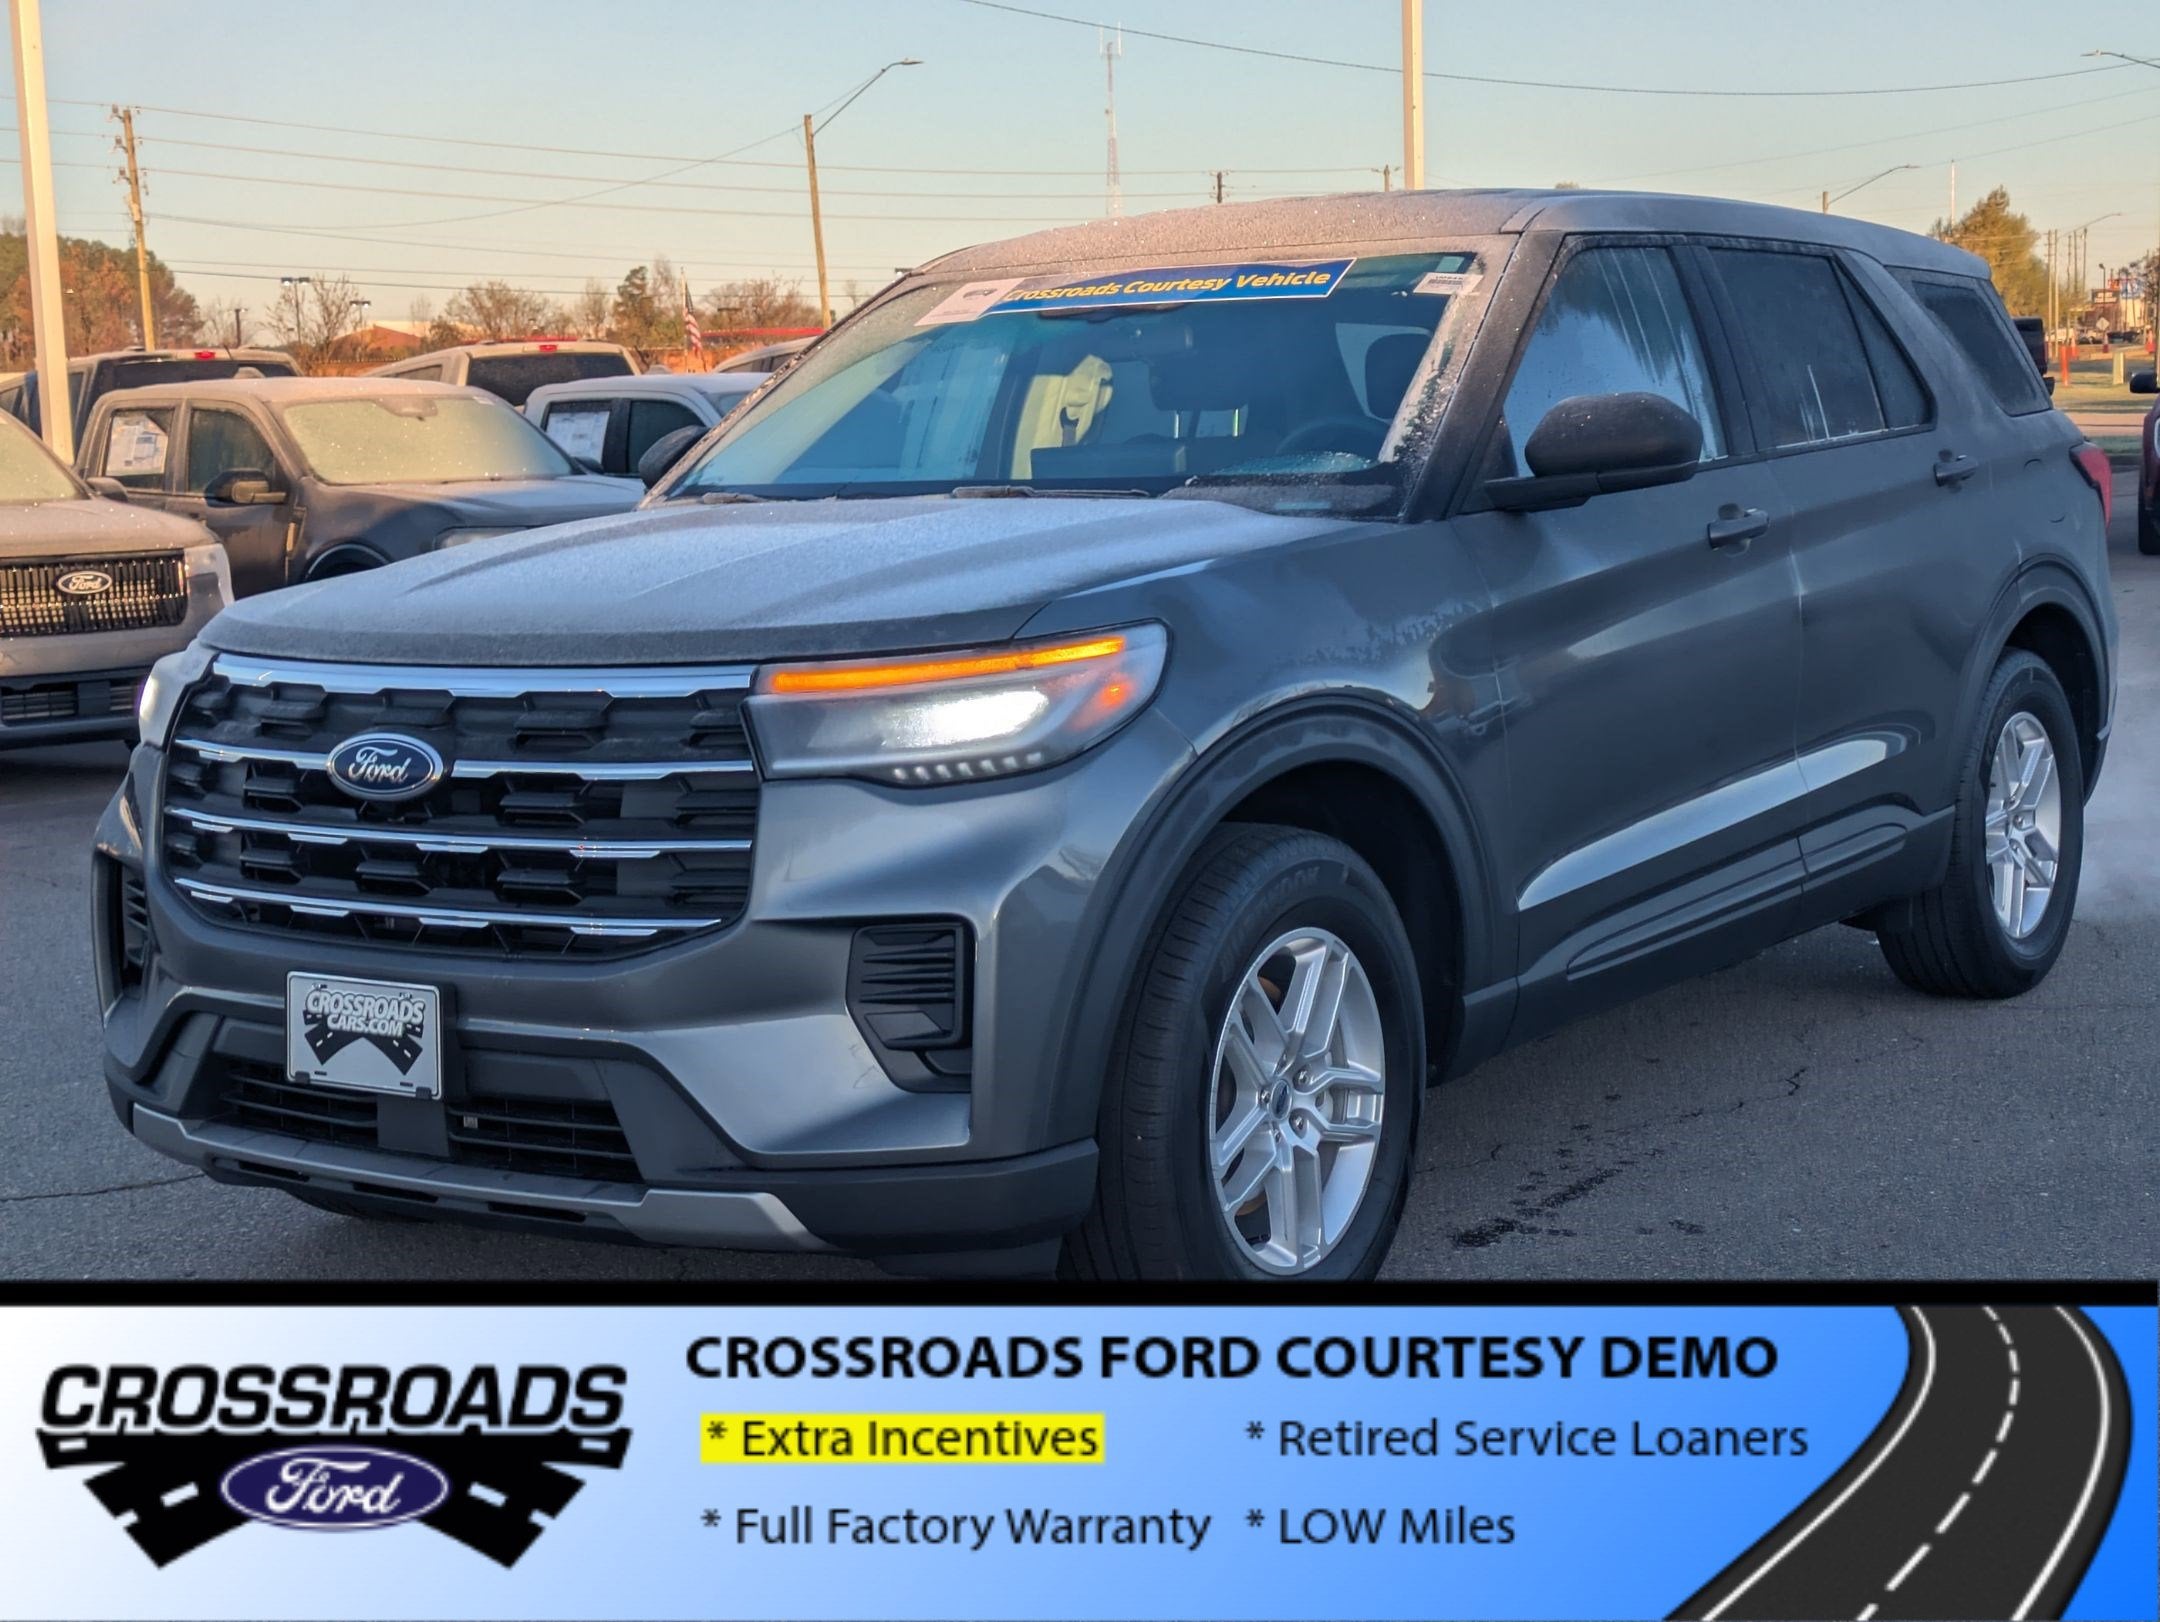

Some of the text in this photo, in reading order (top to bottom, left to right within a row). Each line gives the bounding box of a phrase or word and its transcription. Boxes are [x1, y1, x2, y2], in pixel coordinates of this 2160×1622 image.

[1003, 271, 1332, 301] Crossroads Courtesy Vehicle
[69, 575, 101, 590] Ford
[348, 746, 412, 783] Ford
[306, 990, 425, 1025] CROSSROADS
[327, 1013, 404, 1038] CARS.COM
